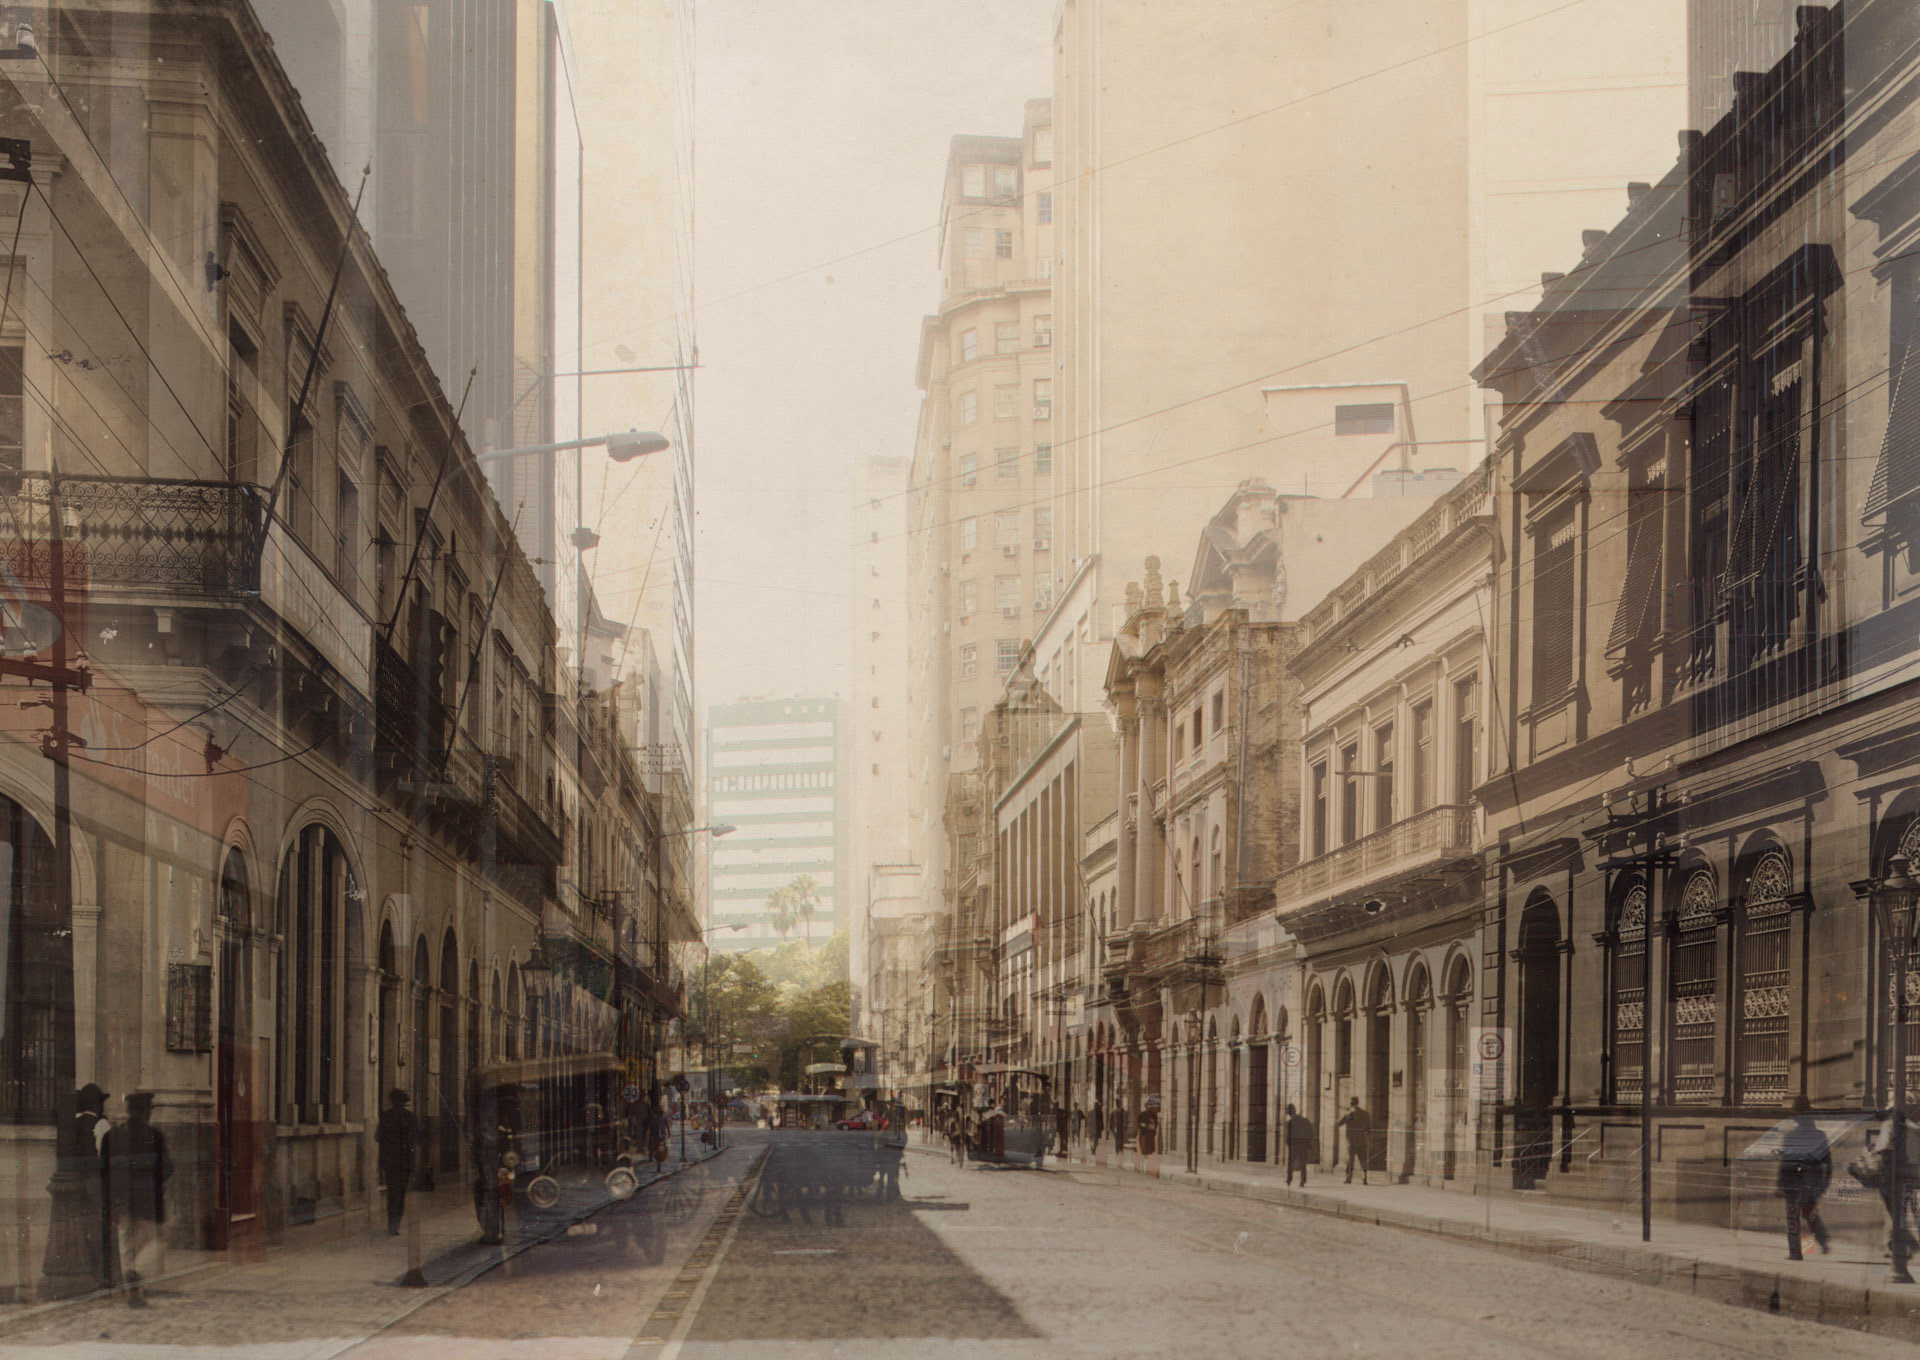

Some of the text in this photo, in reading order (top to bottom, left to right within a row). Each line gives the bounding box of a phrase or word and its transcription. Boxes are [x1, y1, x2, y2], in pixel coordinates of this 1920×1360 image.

[112, 711, 197, 808] Santander
[1287, 1050, 1297, 1063] E
[625, 1087, 637, 1098] 30
